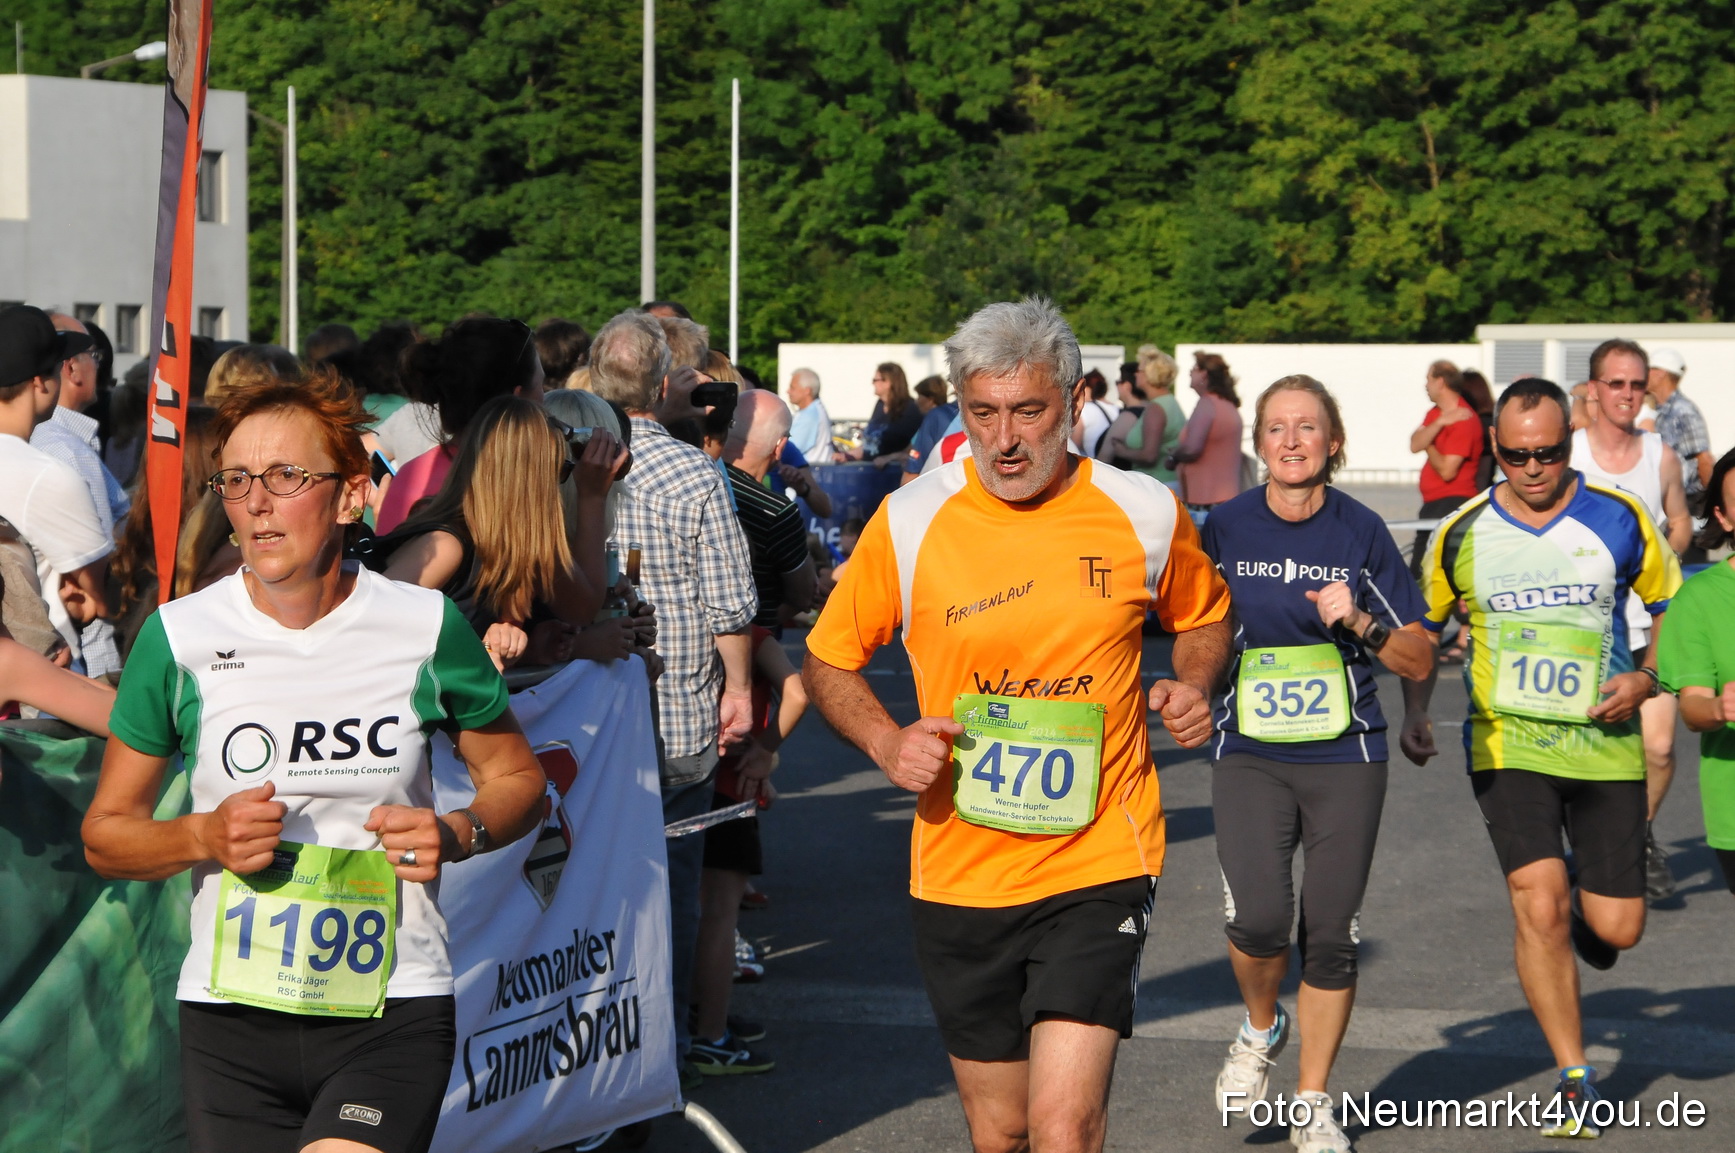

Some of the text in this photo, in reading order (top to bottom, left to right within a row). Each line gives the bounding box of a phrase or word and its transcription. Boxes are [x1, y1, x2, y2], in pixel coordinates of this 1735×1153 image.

[1237, 561, 1350, 582] EURO POLES
[1488, 568, 1559, 590] TEAM
[1488, 584, 1600, 612] BOCK
[211, 661, 245, 671] erima
[1512, 655, 1582, 697] 106
[974, 668, 1094, 698] WERNER
[1253, 679, 1330, 719] 352
[978, 715, 1029, 730] firmenlauf
[1029, 727, 1057, 737] 2014
[288, 716, 400, 763] RSC
[287, 766, 400, 777] Remote Sensing Concepts
[972, 742, 1075, 800] 470
[970, 805, 1037, 821] Handwerker-Service
[1038, 815, 1074, 823] Tschykalo
[995, 798, 1050, 811] Werner Hupfer
[225, 896, 386, 975] 1198
[277, 972, 329, 987] Erika Jäger
[489, 928, 616, 1015] Neumarkter
[277, 987, 325, 999] RSC GmbH
[463, 984, 641, 1113] Lammsbräu
